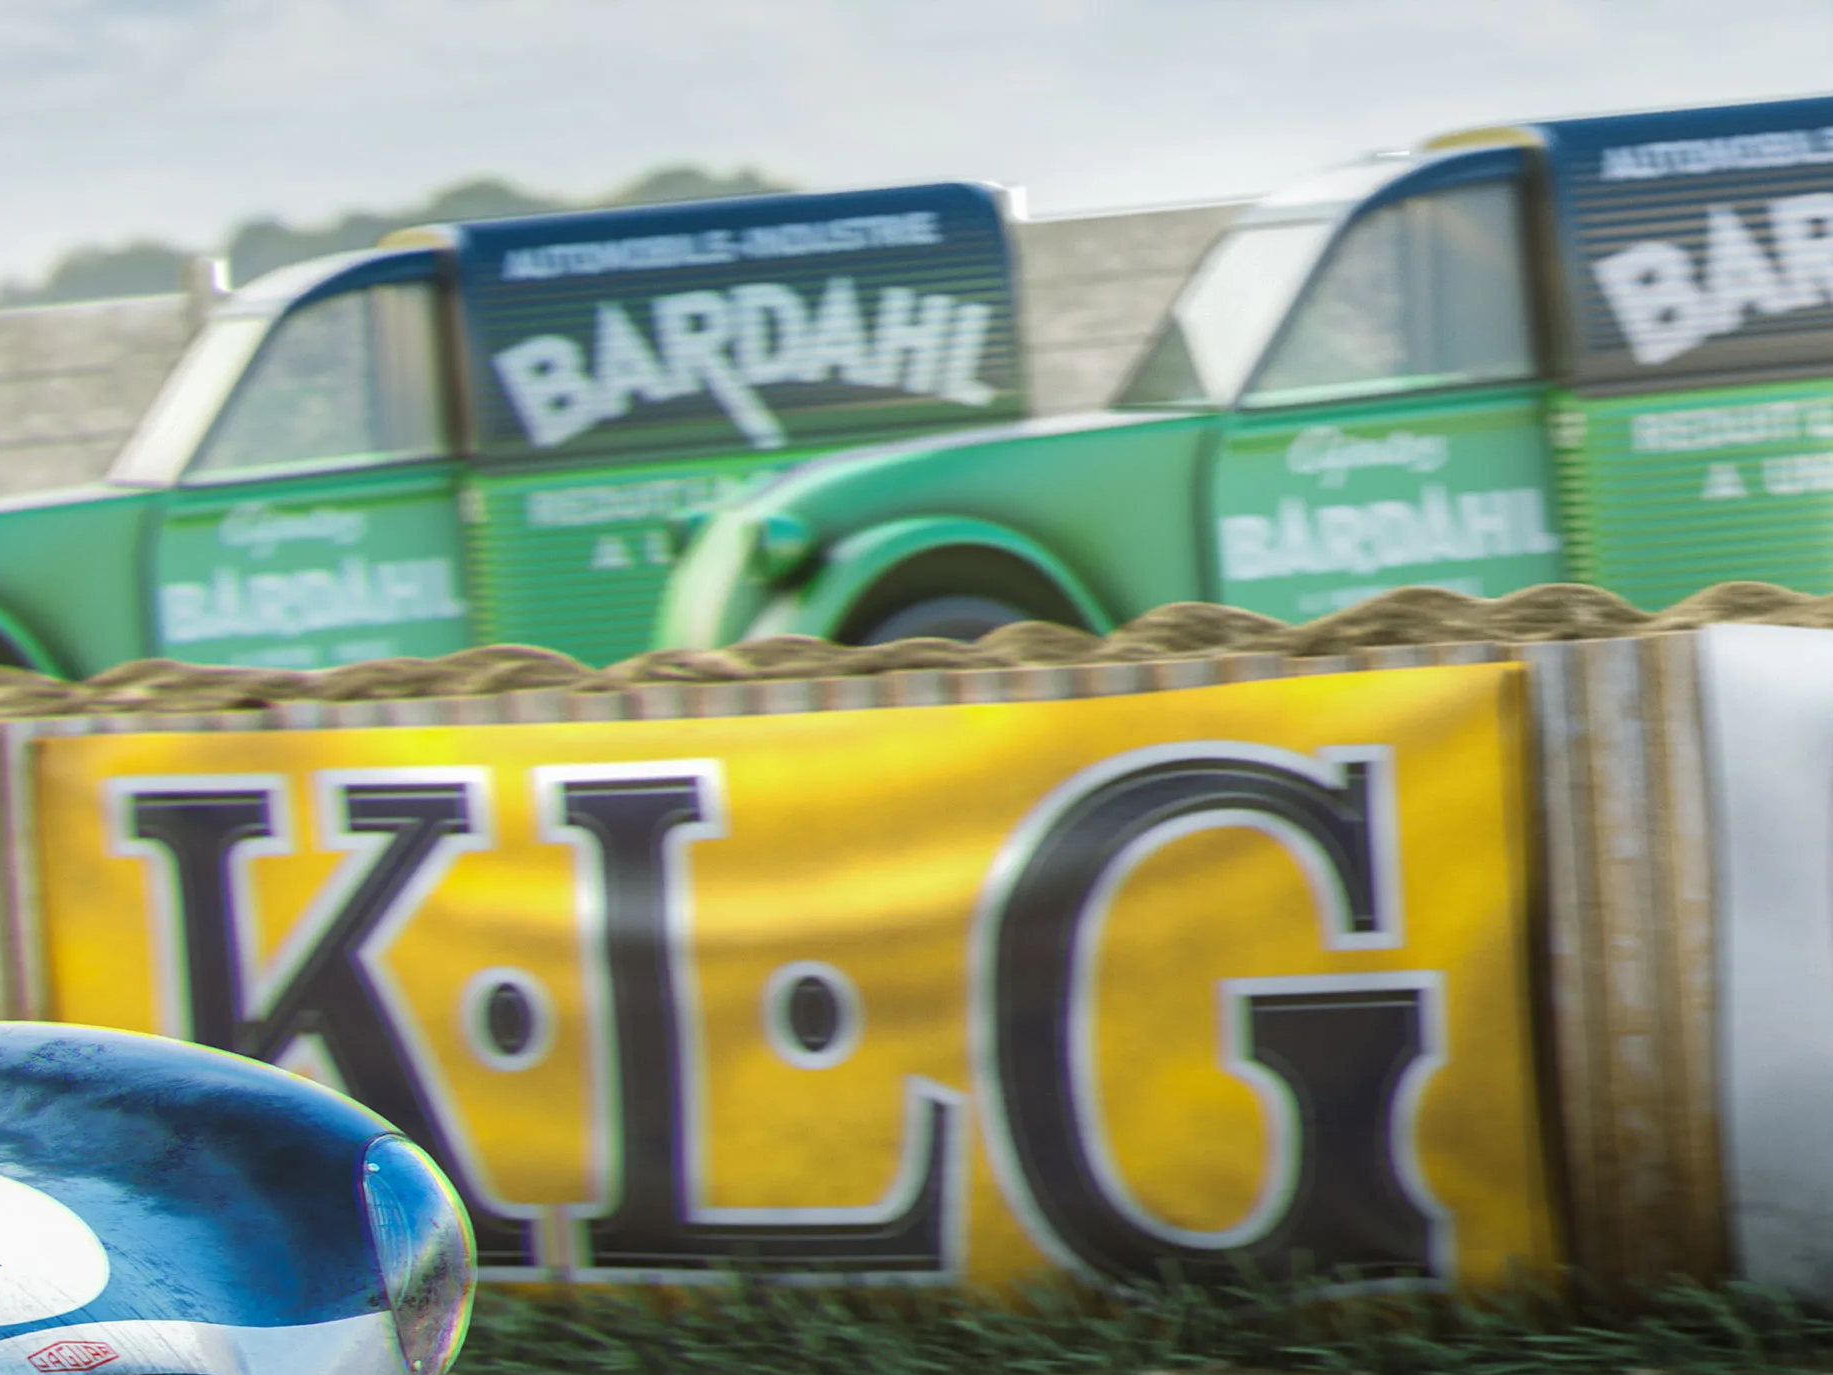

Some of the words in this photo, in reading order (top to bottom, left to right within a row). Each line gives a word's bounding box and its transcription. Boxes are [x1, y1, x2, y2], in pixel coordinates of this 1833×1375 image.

[490, 276, 997, 449] BARDAHL
[1220, 483, 1564, 581] BARDAHL
[160, 554, 466, 644] BARDAHL
[36, 1343, 110, 1369] JAGUAR
